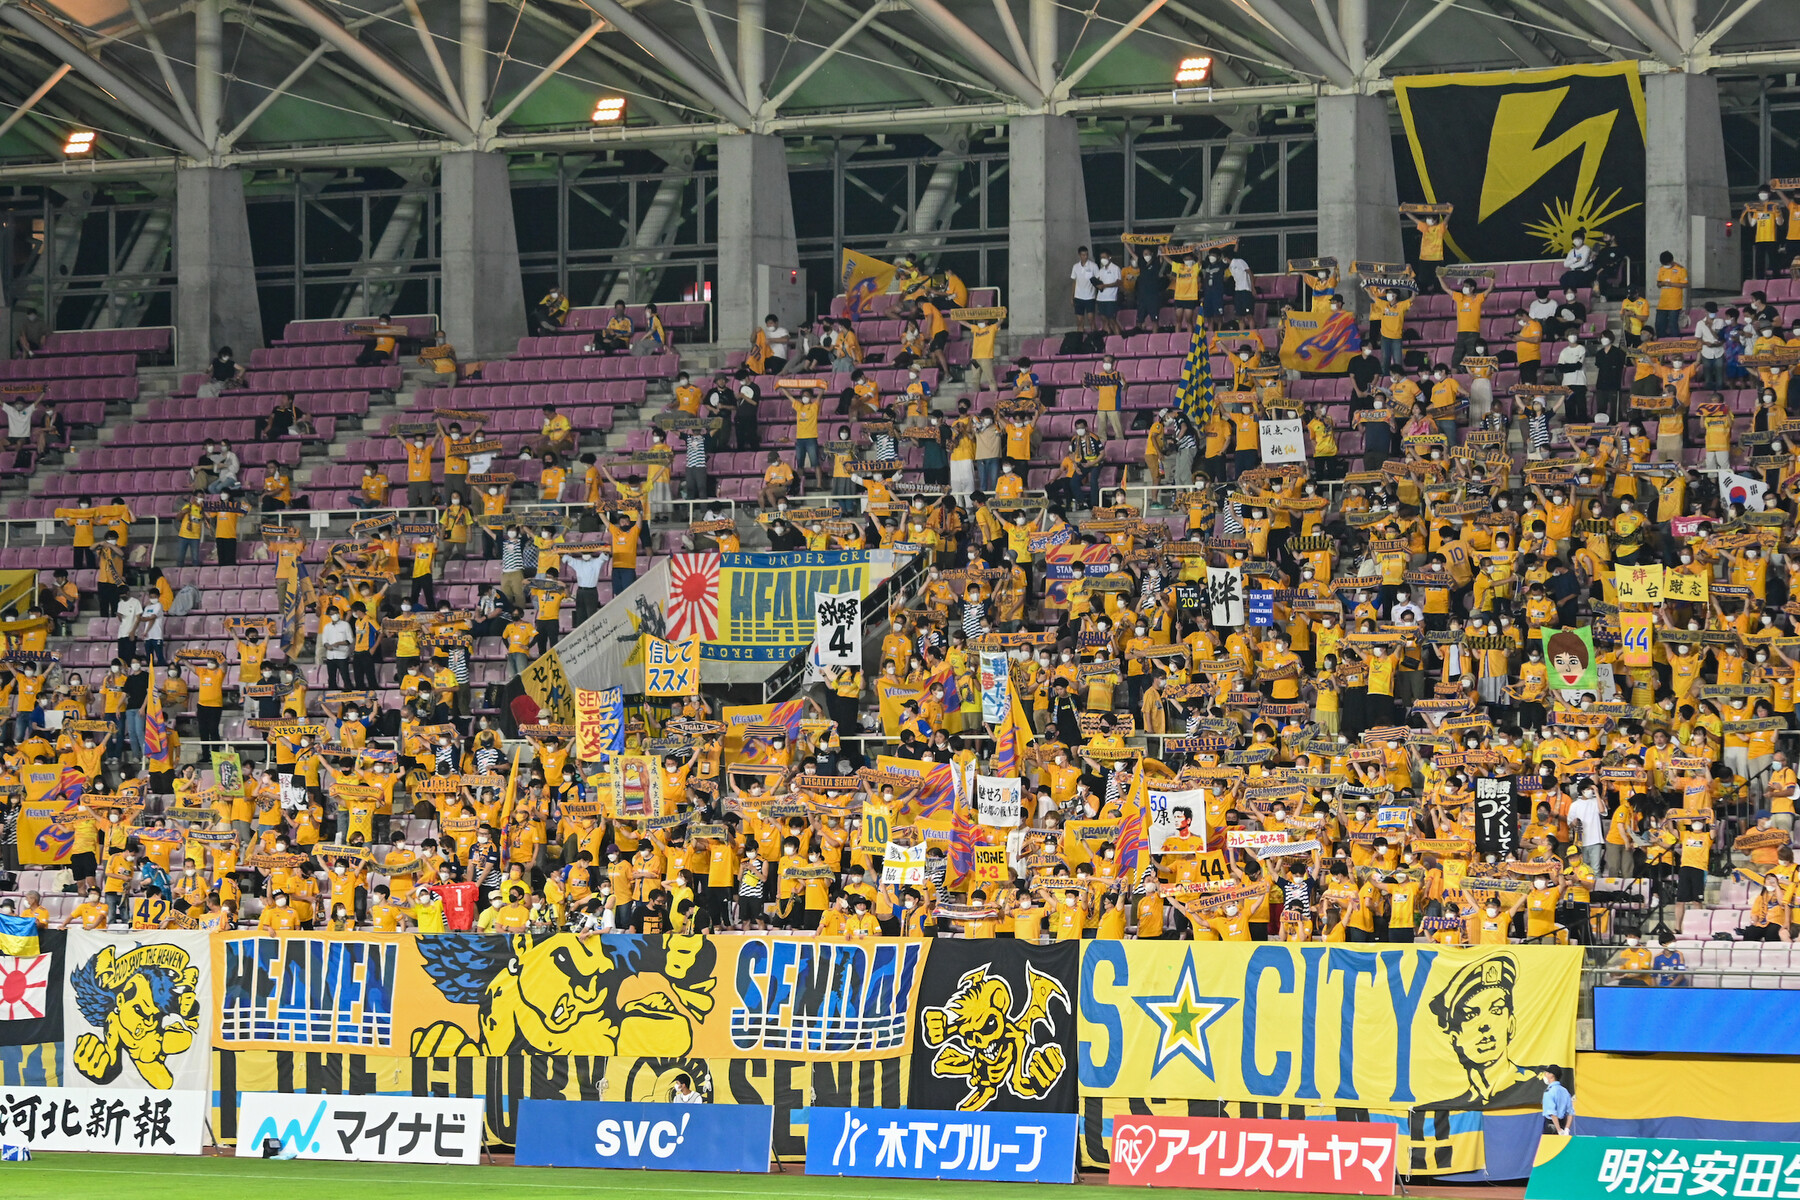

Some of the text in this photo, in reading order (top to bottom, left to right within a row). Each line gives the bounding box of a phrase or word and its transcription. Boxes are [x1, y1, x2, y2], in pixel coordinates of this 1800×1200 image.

[1289, 319, 1318, 329] VEGALTA
[769, 552, 824, 566] UNDER
[1450, 547, 1464, 562] 10
[1632, 569, 1647, 585] 絆
[1619, 582, 1659, 596] 仙台
[1181, 599, 1194, 608] 20
[1210, 571, 1240, 624] 絆
[829, 625, 853, 658] 4
[1426, 630, 1450, 641] CRAWL
[1624, 627, 1648, 653] 44
[5, 650, 52, 659] VEGALTA
[578, 688, 622, 708] SENDAI
[1262, 704, 1287, 714] VEGALTA
[1598, 704, 1635, 713] CRAWL UP
[731, 714, 763, 725] VEGALTA
[1562, 714, 1600, 724] 仙 台
[274, 725, 320, 734] VEGALTA
[680, 723, 708, 731] VEGALTA
[322, 744, 352, 752] VEGALTA
[650, 737, 678, 746] CRAWL
[1176, 737, 1225, 747] VEGALTA
[1308, 742, 1347, 751] CRAWL UP
[28, 773, 55, 783] VEGALTA
[804, 777, 837, 787] VEGALTA
[565, 804, 597, 814] VEGALTA
[770, 805, 797, 814] CRAWL
[1151, 796, 1167, 811] 50
[647, 812, 692, 828] CRAWL UP
[866, 814, 888, 844] 10
[1083, 826, 1108, 835] CRAW
[1230, 834, 1285, 845] カレーは飲み物
[976, 851, 1004, 863] HOME
[979, 866, 999, 879] +3
[1200, 859, 1224, 880] 44
[1472, 881, 1518, 890] CRAWL UP
[456, 889, 462, 907] 1
[1199, 892, 1232, 906] VEGALTA
[137, 900, 166, 923] 42
[146, 948, 157, 964] THE
[157, 948, 184, 970] HEAVEN
[222, 937, 398, 1046] HEAVEN
[730, 937, 922, 1053] SENDAI
[1241, 945, 1439, 1104] CITY
[0, 1094, 176, 1148] 河北新報
[334, 1111, 466, 1158] マイナビ
[595, 1112, 691, 1158] SVC!
[875, 1122, 1047, 1174] 木下グループ
[1114, 1136, 1142, 1163] IRIS
[1155, 1126, 1393, 1181] アイリスオーヤマ
